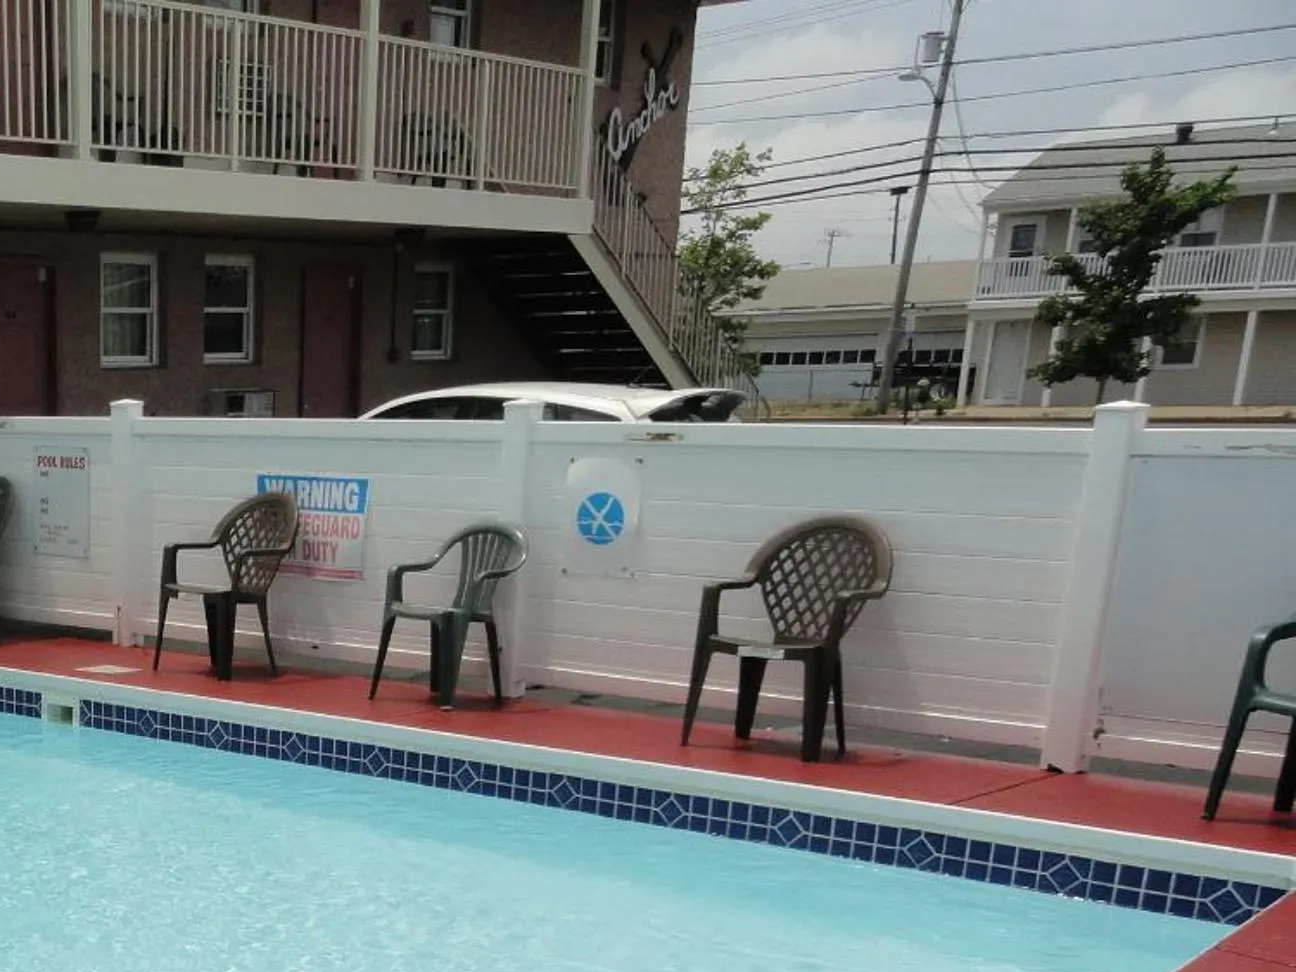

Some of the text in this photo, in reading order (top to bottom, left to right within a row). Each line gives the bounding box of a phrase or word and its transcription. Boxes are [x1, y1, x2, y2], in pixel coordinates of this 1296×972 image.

[37, 455, 85, 470] POOL RULES
[298, 514, 361, 540] EGUARD
[302, 539, 338, 562] DUTY
